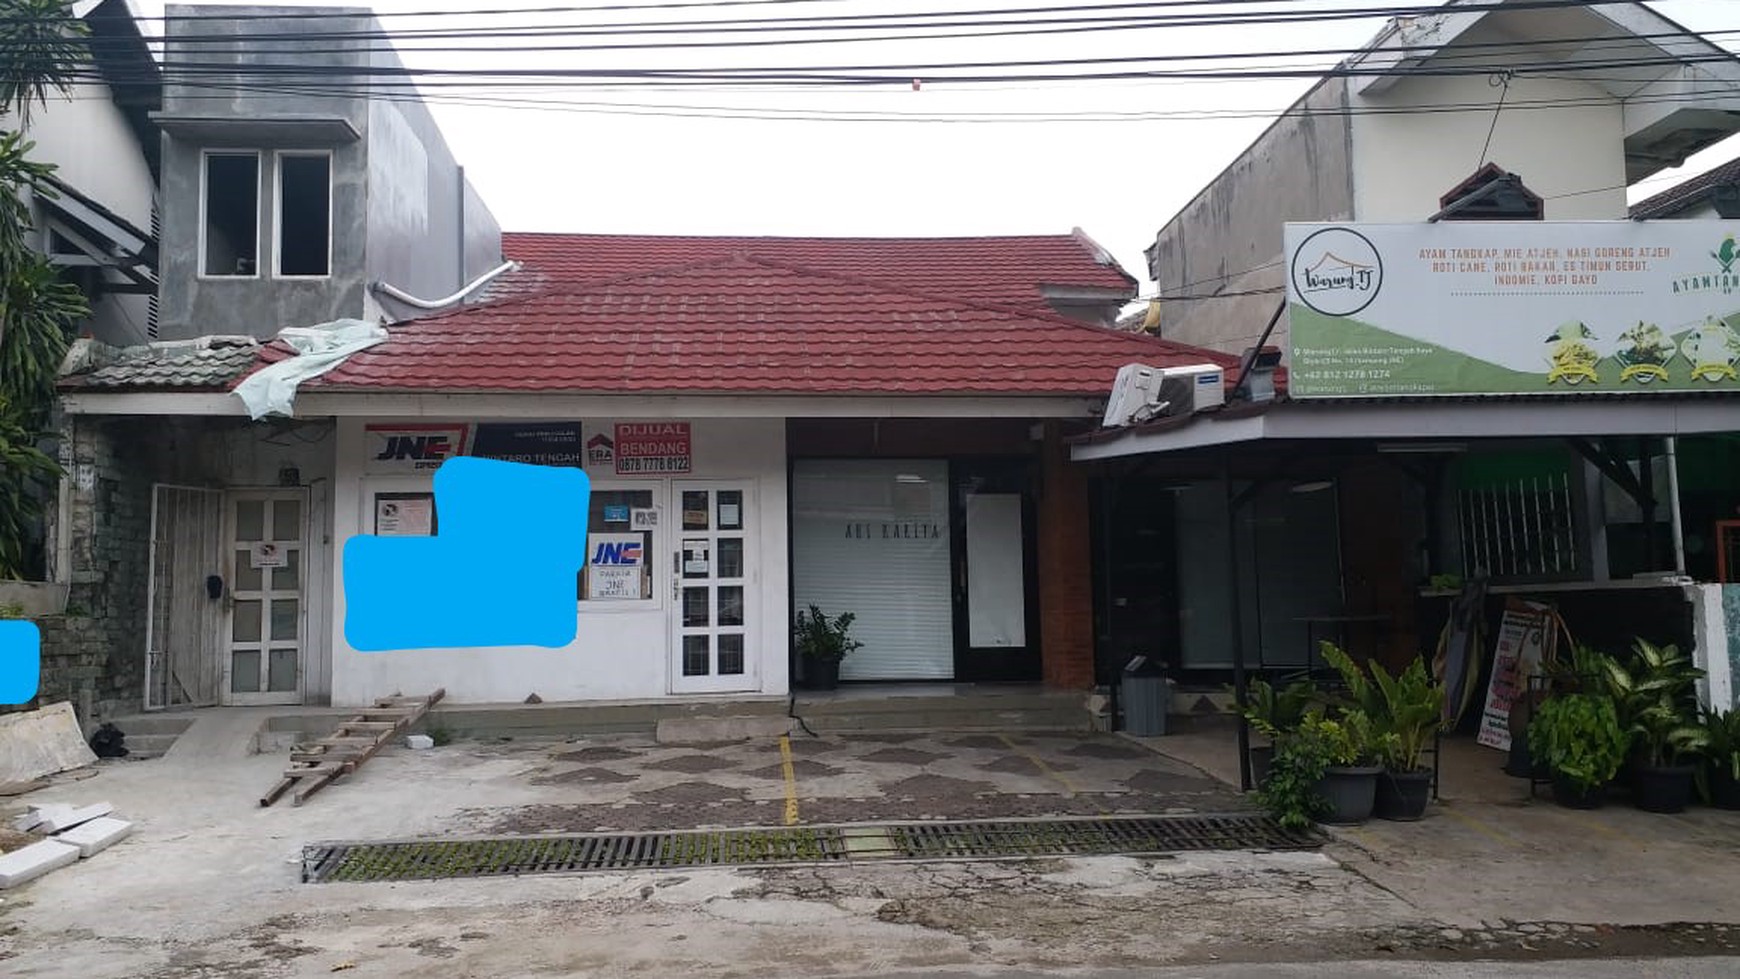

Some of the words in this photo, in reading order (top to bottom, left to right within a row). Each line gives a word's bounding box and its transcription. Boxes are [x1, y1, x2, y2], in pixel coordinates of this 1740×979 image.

[1419, 248, 1447, 259] AYAM
[1504, 248, 1522, 259] MIE
[1566, 247, 1591, 258] NASI
[1594, 247, 1635, 258] GORENG
[1639, 247, 1670, 258] ATJEH
[1432, 262, 1456, 272] ROTI
[1494, 261, 1517, 272] ROTI
[1563, 261, 1577, 271] ES
[1580, 261, 1612, 271] TIMUN
[1544, 274, 1568, 285] KOPI
[619, 424, 688, 436] DIJUAL
[376, 435, 451, 461] JNE
[620, 442, 687, 455] BENDANG
[591, 541, 643, 565] JNE
